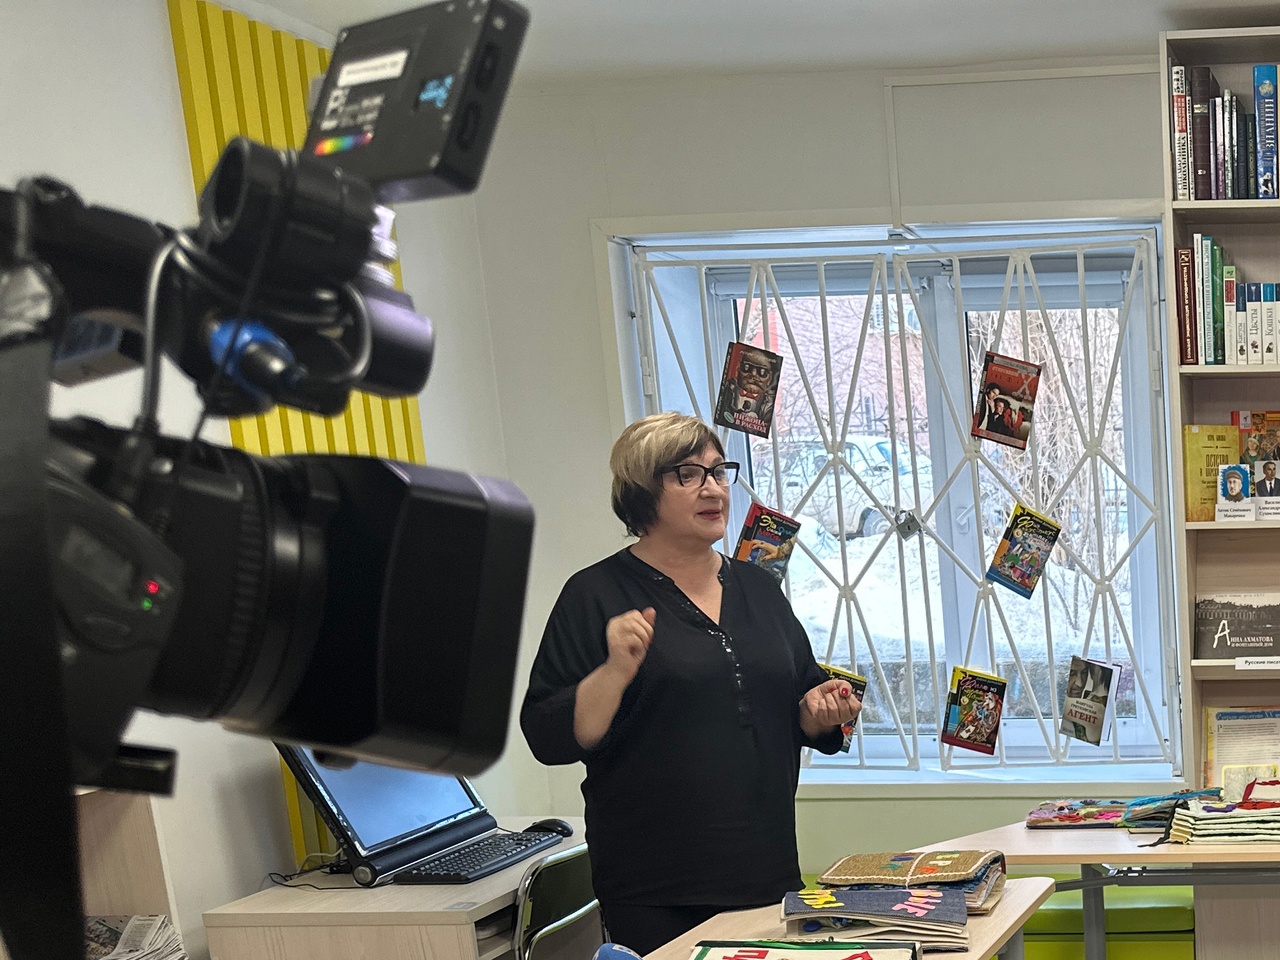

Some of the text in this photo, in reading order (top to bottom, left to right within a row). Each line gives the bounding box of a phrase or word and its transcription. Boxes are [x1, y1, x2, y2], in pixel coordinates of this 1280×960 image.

[1264, 98, 1275, 149] ЗНАНИЙ
[1250, 308, 1259, 335] Цветы
[1265, 308, 1273, 336] Кошки
[741, 420, 767, 434] РАСХОД
[1067, 709, 1098, 725] АГЕНТ
